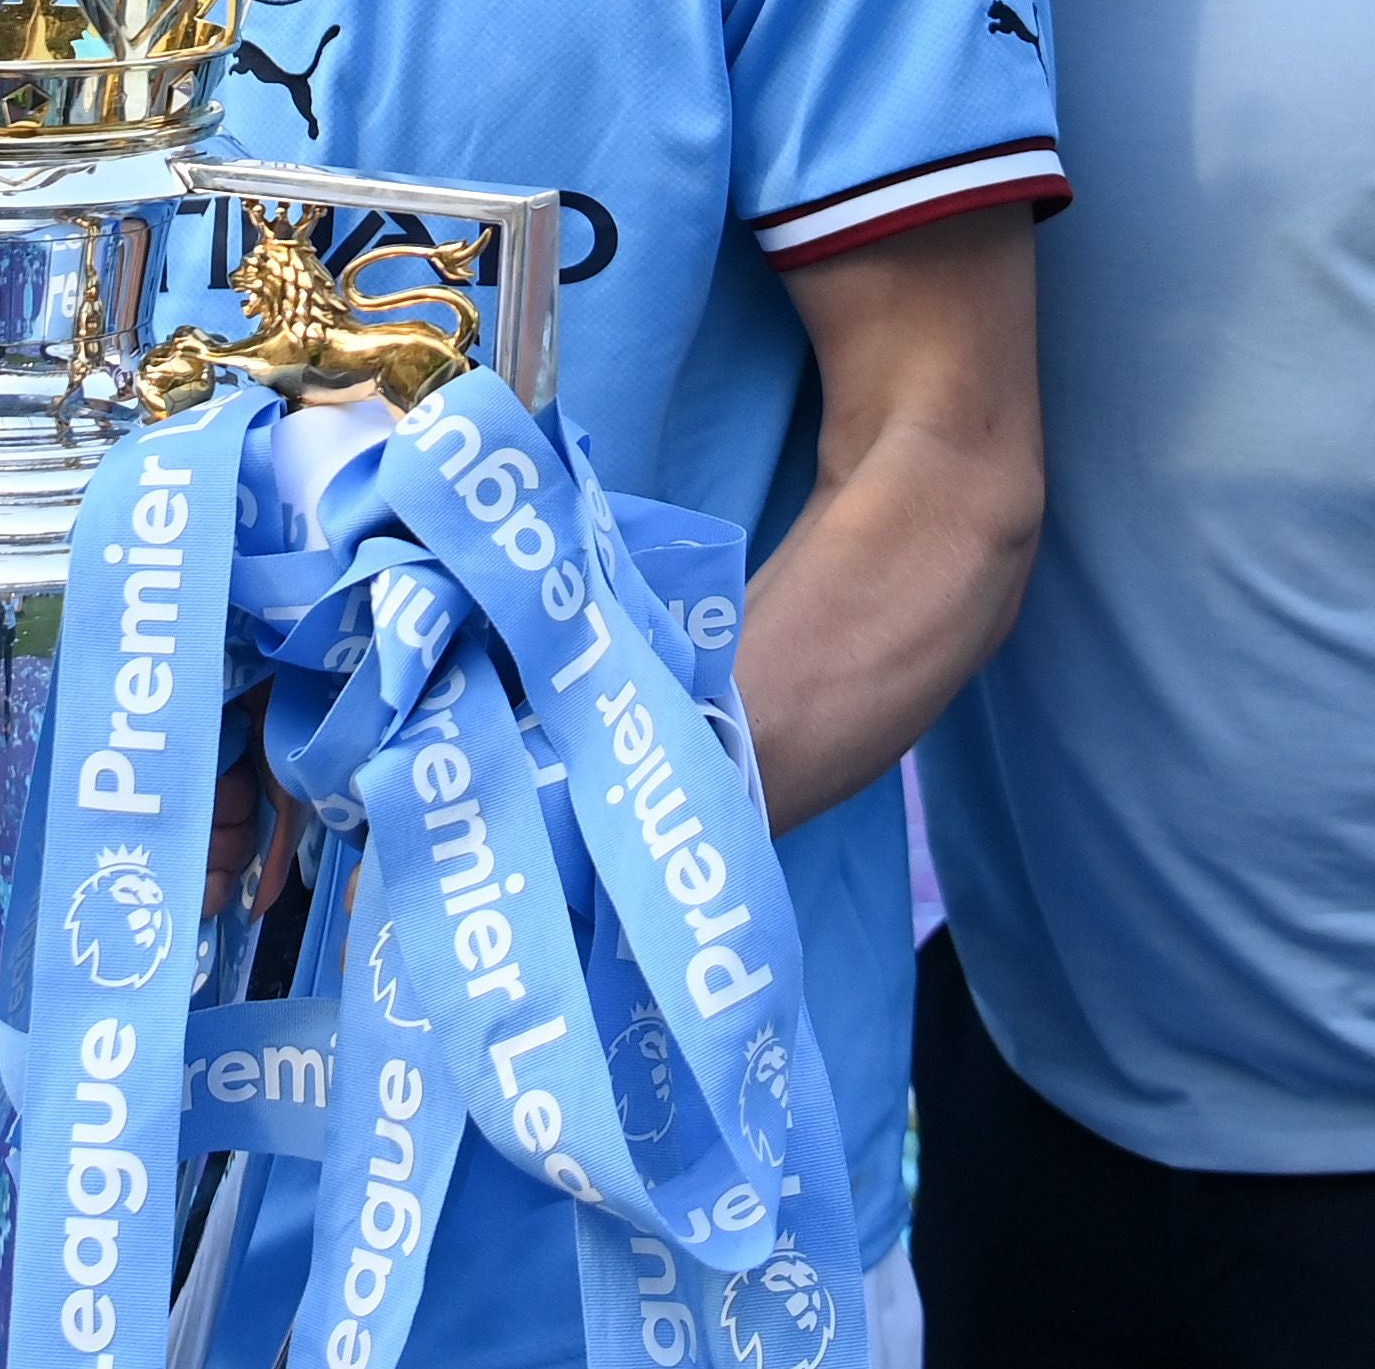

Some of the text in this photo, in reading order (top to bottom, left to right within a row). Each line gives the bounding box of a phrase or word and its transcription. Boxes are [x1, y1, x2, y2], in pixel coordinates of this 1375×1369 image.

[78, 454, 194, 815] Premier
[395, 390, 612, 694] League
[596, 680, 774, 1019] Premier
